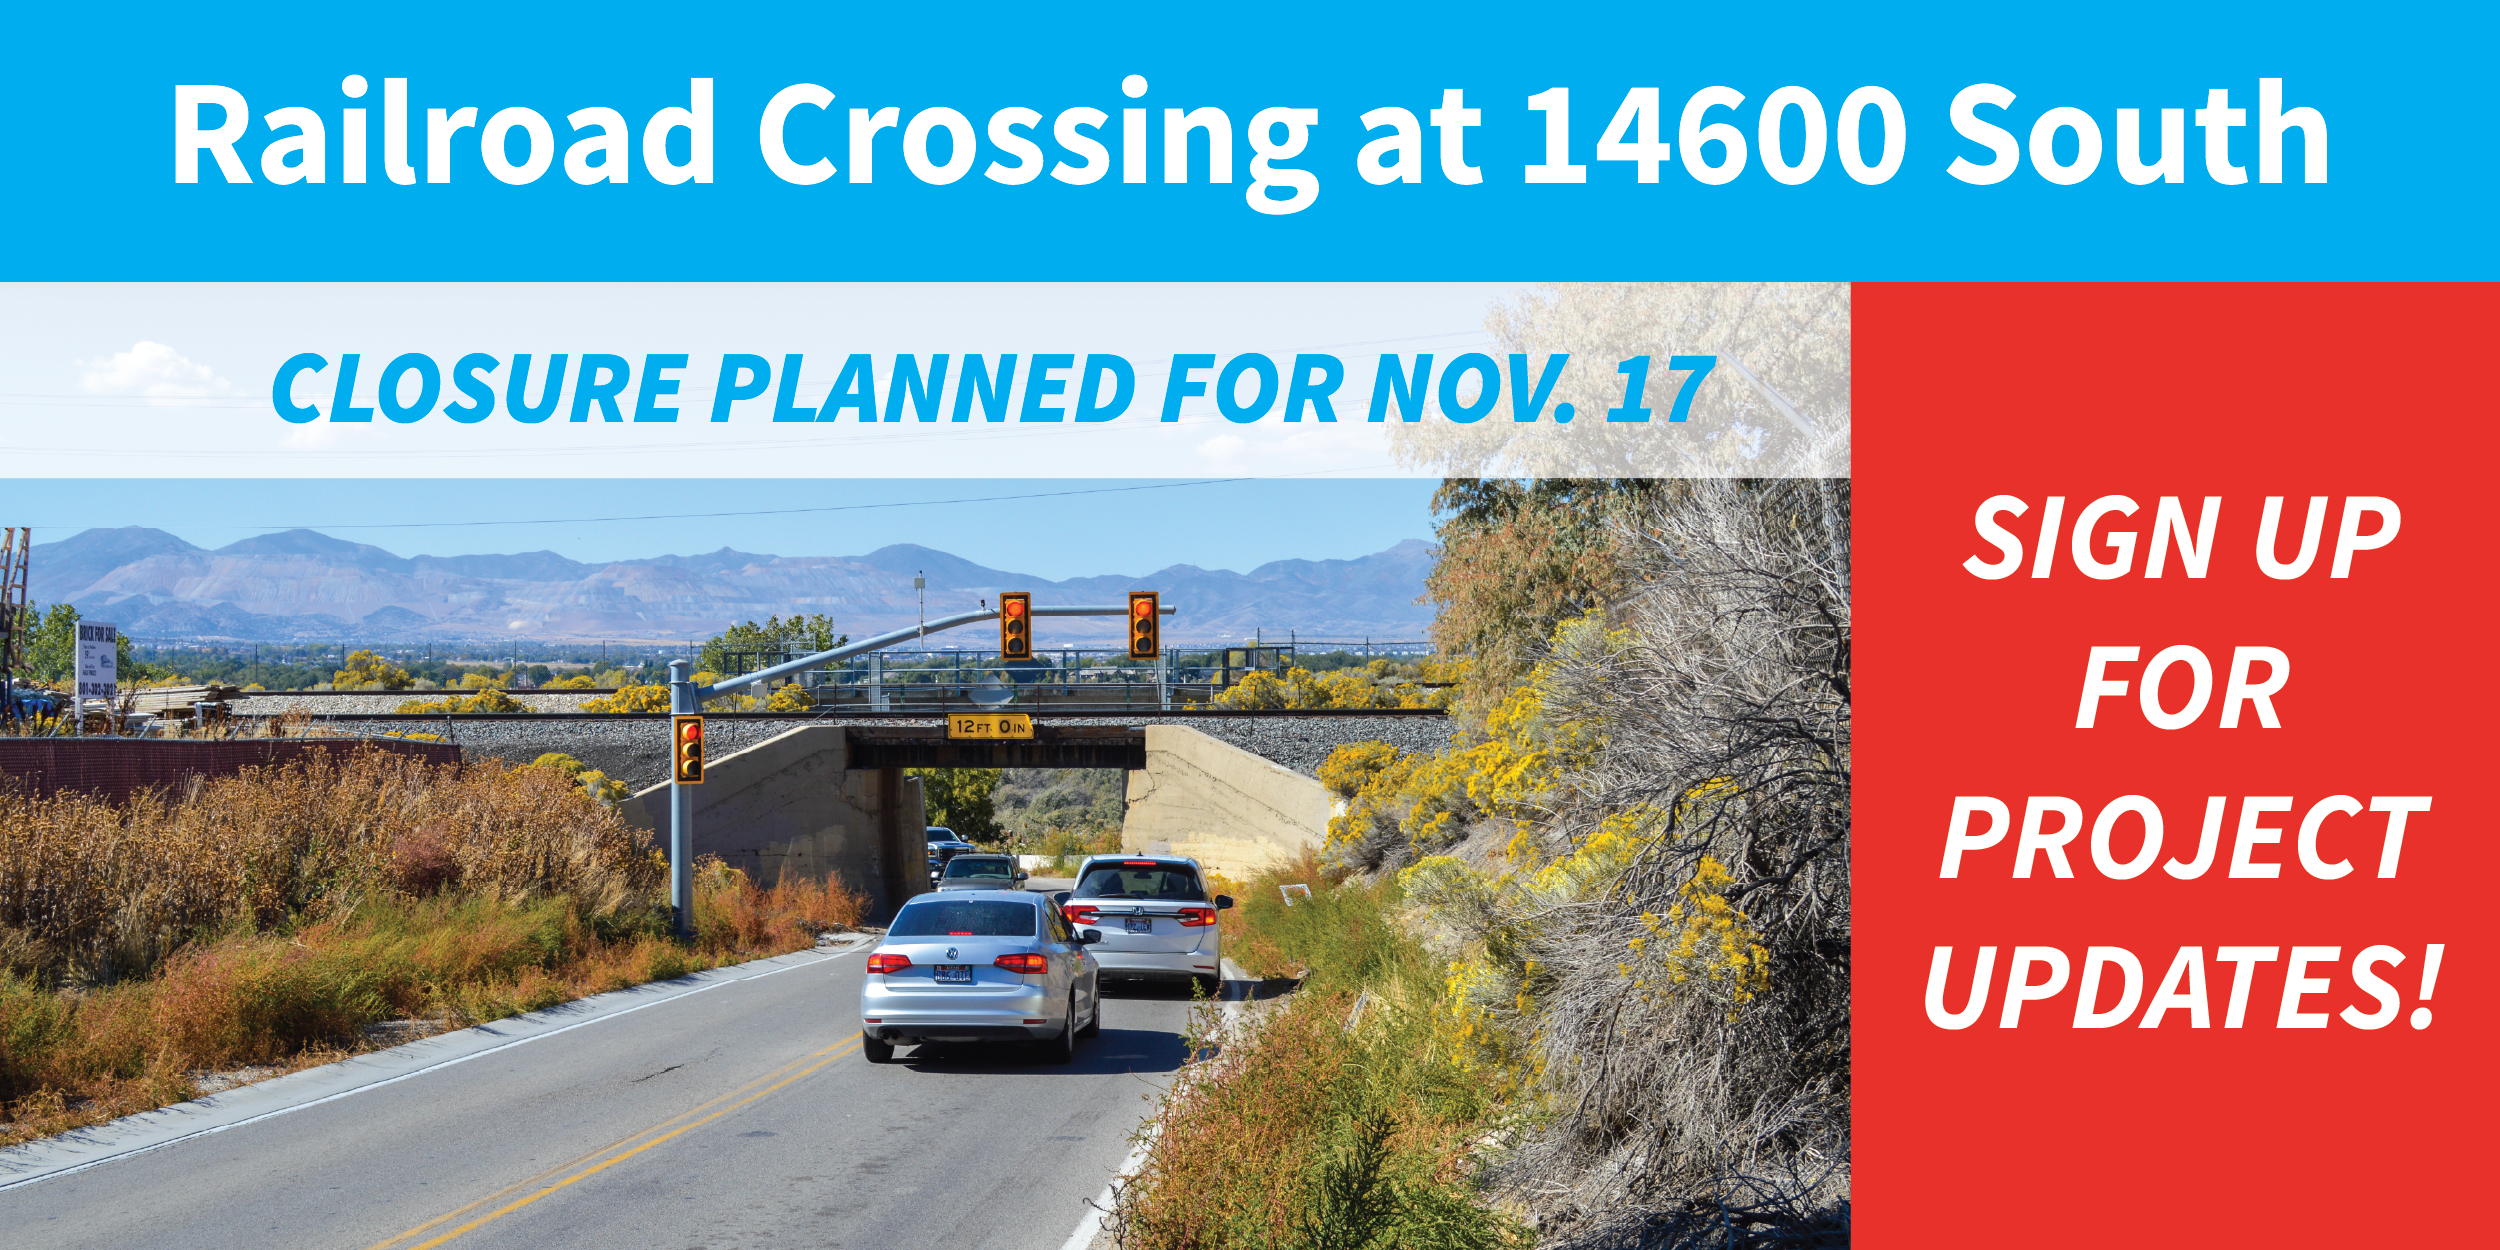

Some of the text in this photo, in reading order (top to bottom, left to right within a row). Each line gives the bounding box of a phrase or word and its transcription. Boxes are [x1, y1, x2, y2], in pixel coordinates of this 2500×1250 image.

[80, 625, 116, 643] BRICK FOR SALE
